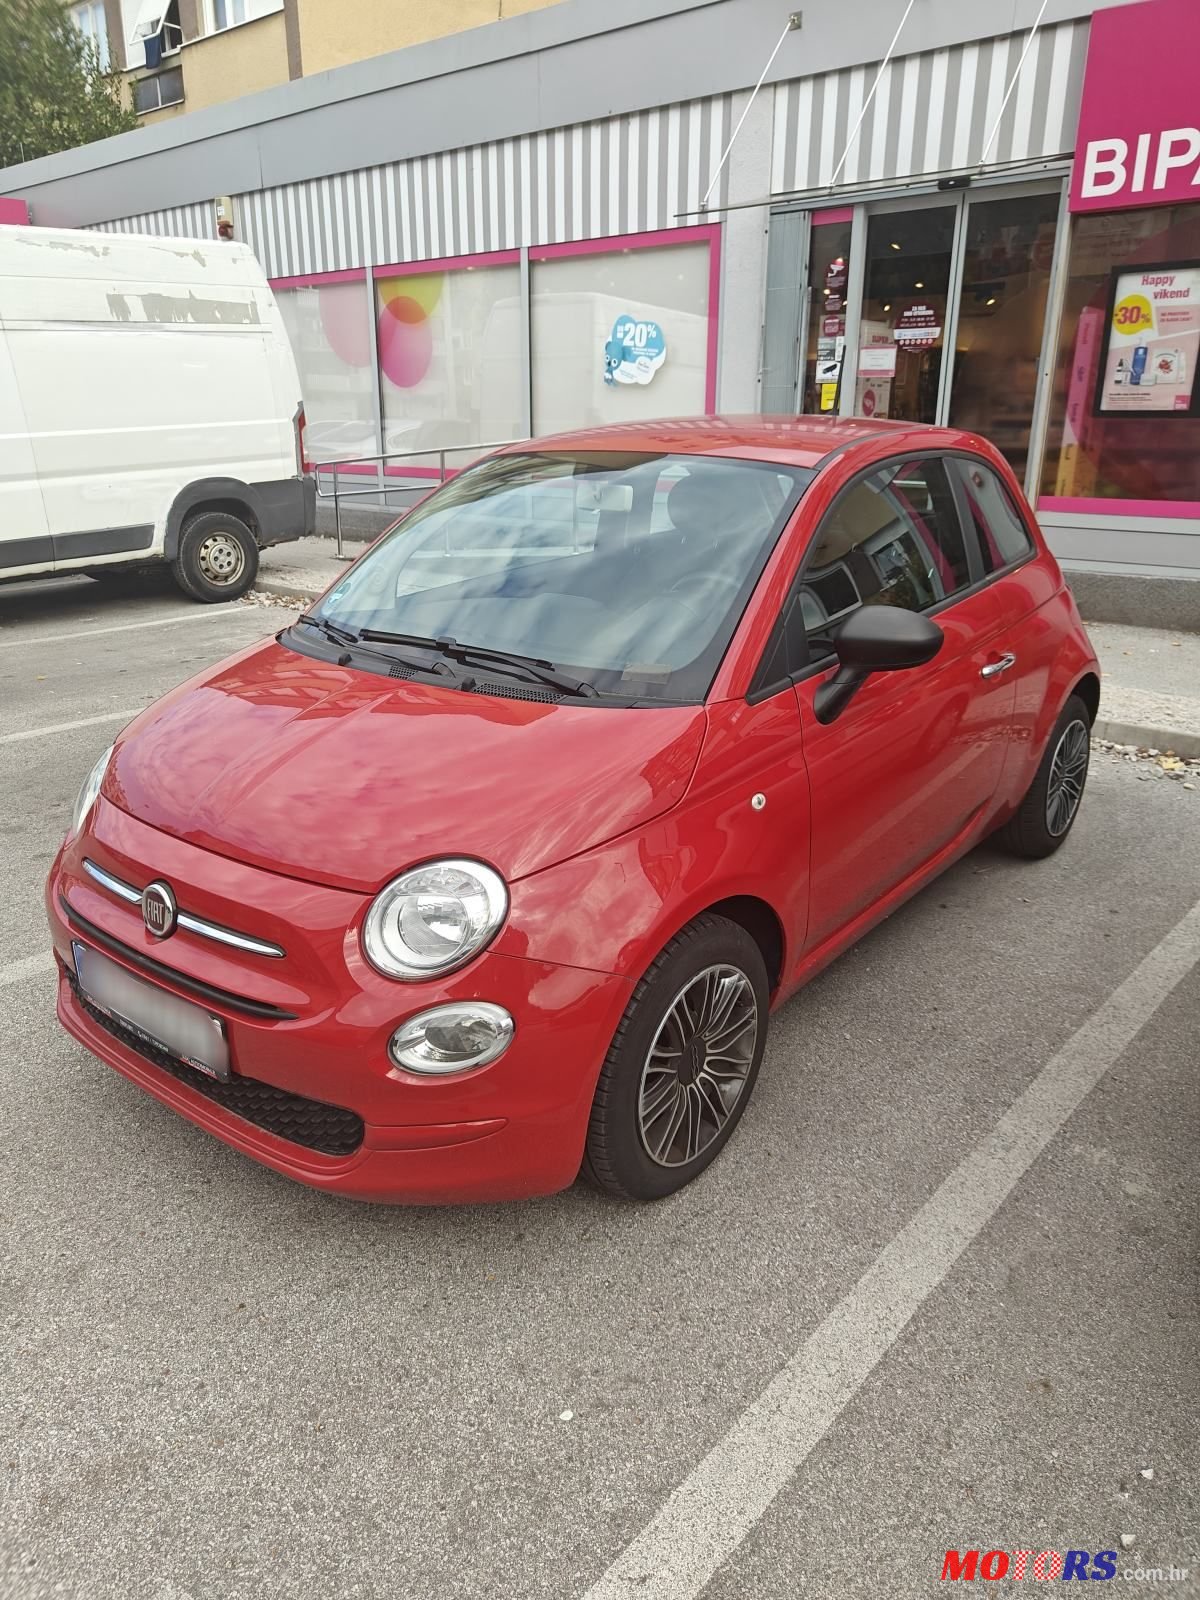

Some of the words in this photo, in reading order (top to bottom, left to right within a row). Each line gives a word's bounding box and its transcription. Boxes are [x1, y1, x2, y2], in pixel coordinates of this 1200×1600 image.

[1081, 127, 1200, 198] BIP
[1141, 274, 1176, 287] Happy
[1153, 287, 1190, 300] vikend
[623, 322, 657, 348] 20%
[147, 898, 164, 925] FIAT
